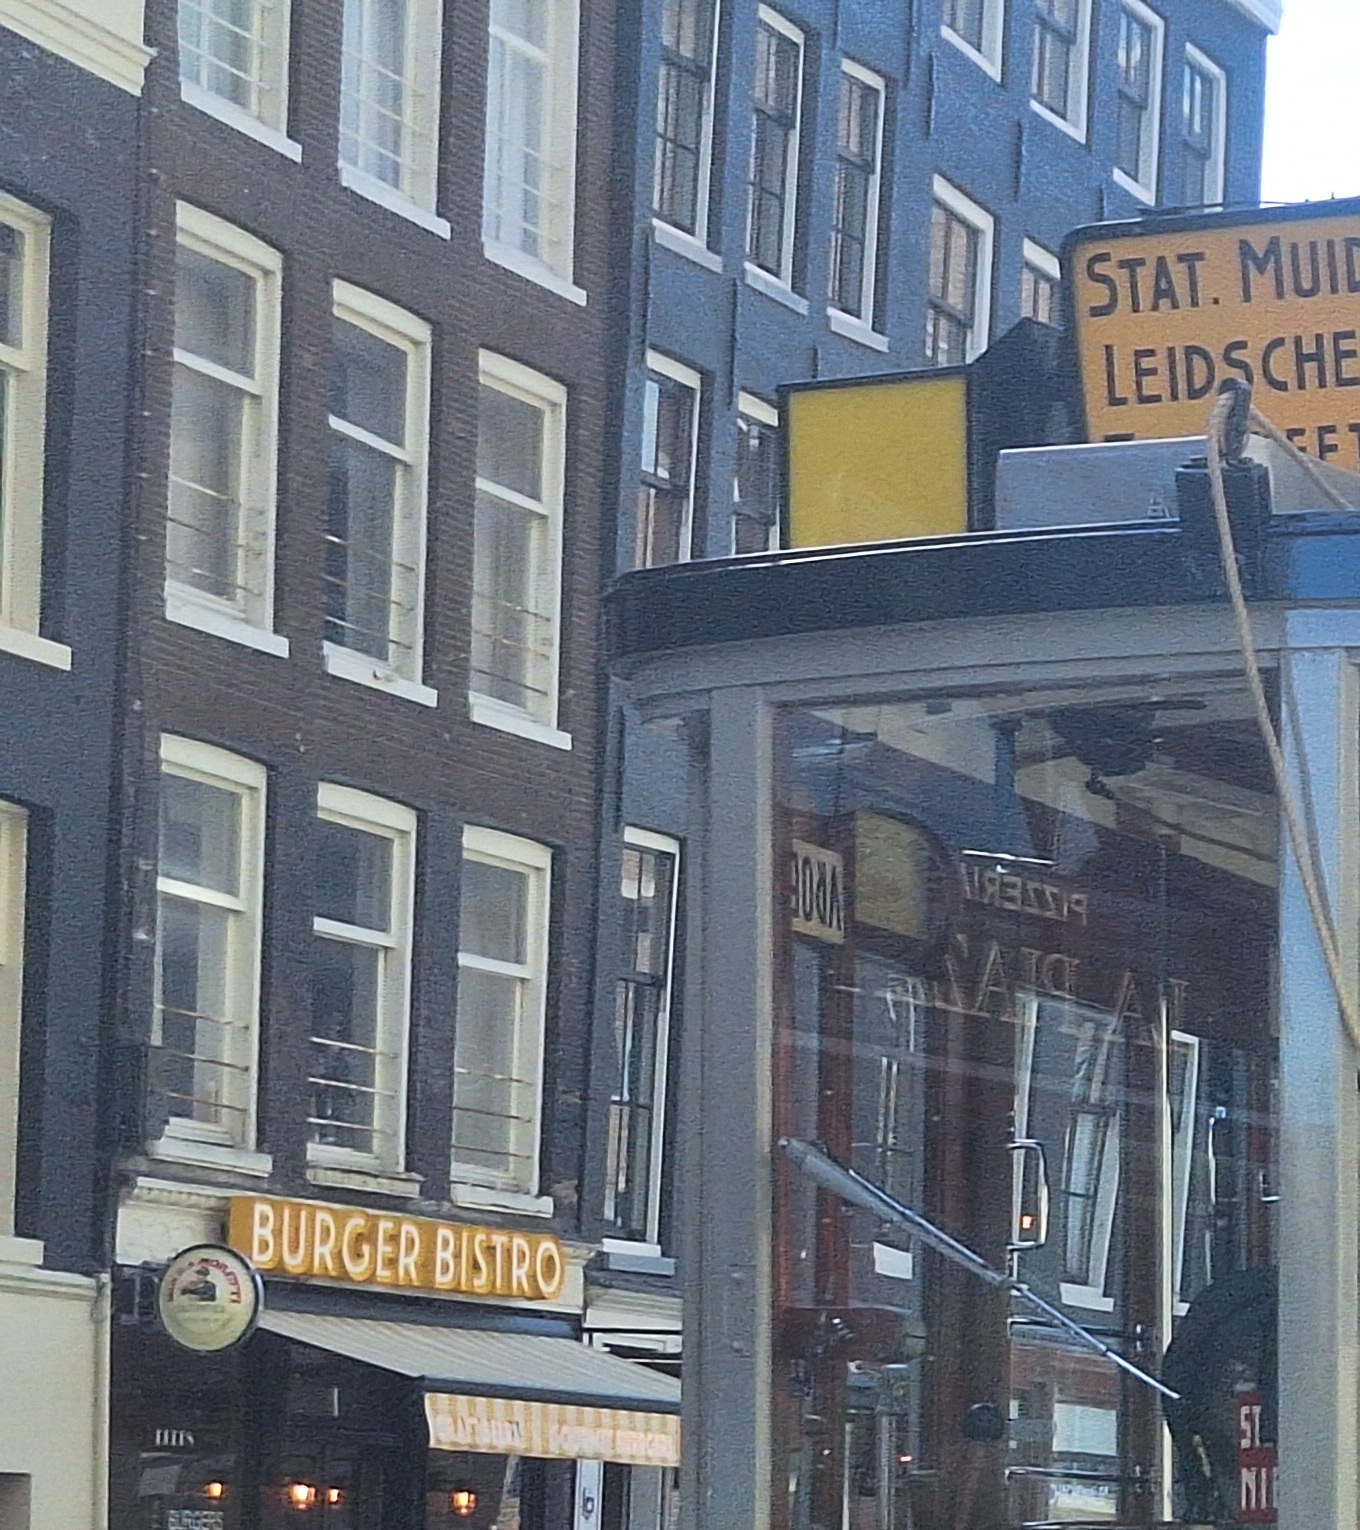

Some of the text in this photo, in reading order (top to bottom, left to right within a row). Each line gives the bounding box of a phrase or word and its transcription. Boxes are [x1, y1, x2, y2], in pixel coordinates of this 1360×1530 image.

[1086, 252, 1220, 317] STAT.
[251, 1204, 421, 1286] BURGER
[434, 1227, 563, 1299] BISTRO
